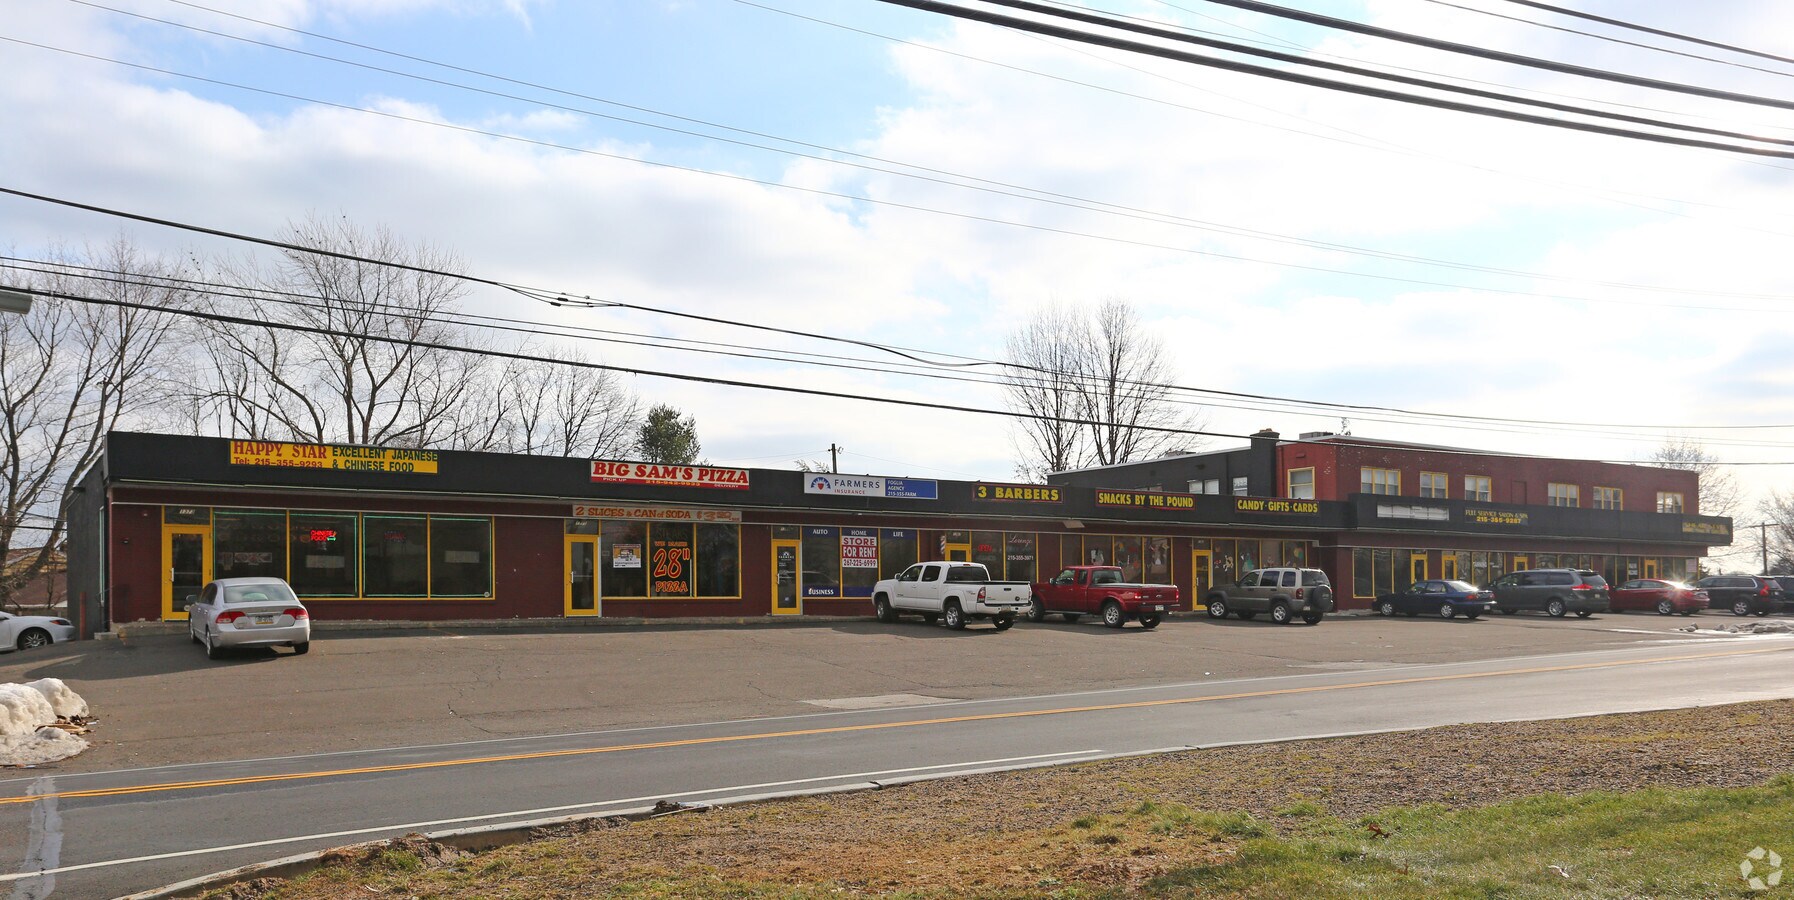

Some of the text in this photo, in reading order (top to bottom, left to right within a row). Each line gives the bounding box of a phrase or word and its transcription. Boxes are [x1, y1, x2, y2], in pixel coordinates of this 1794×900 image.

[234, 441, 327, 459] HAPPY STAR
[332, 446, 438, 461] EXCELLENT JAPANESE
[234, 457, 323, 468] Tel: 215-355-9293
[332, 459, 414, 472] & CHINESE FOOD
[593, 461, 748, 483] BIG SAM'S PIZZA
[834, 479, 880, 489] FARMERS
[978, 486, 1059, 501] 3 BARBERS
[1098, 492, 1193, 507] SNACKS BY THE POUND
[576, 506, 585, 515] 2
[588, 507, 624, 517] SLICES
[634, 509, 656, 518] CAN
[666, 510, 691, 519] SODA
[1237, 499, 1318, 513] CANDY GIFTS CARDS
[843, 537, 875, 546] STORE
[843, 546, 876, 558] FOR RENT
[653, 547, 690, 578] 28"
[843, 559, 876, 567] 267-225-6999
[655, 580, 689, 592] PIZZA
[809, 587, 834, 595] BUSINESS
